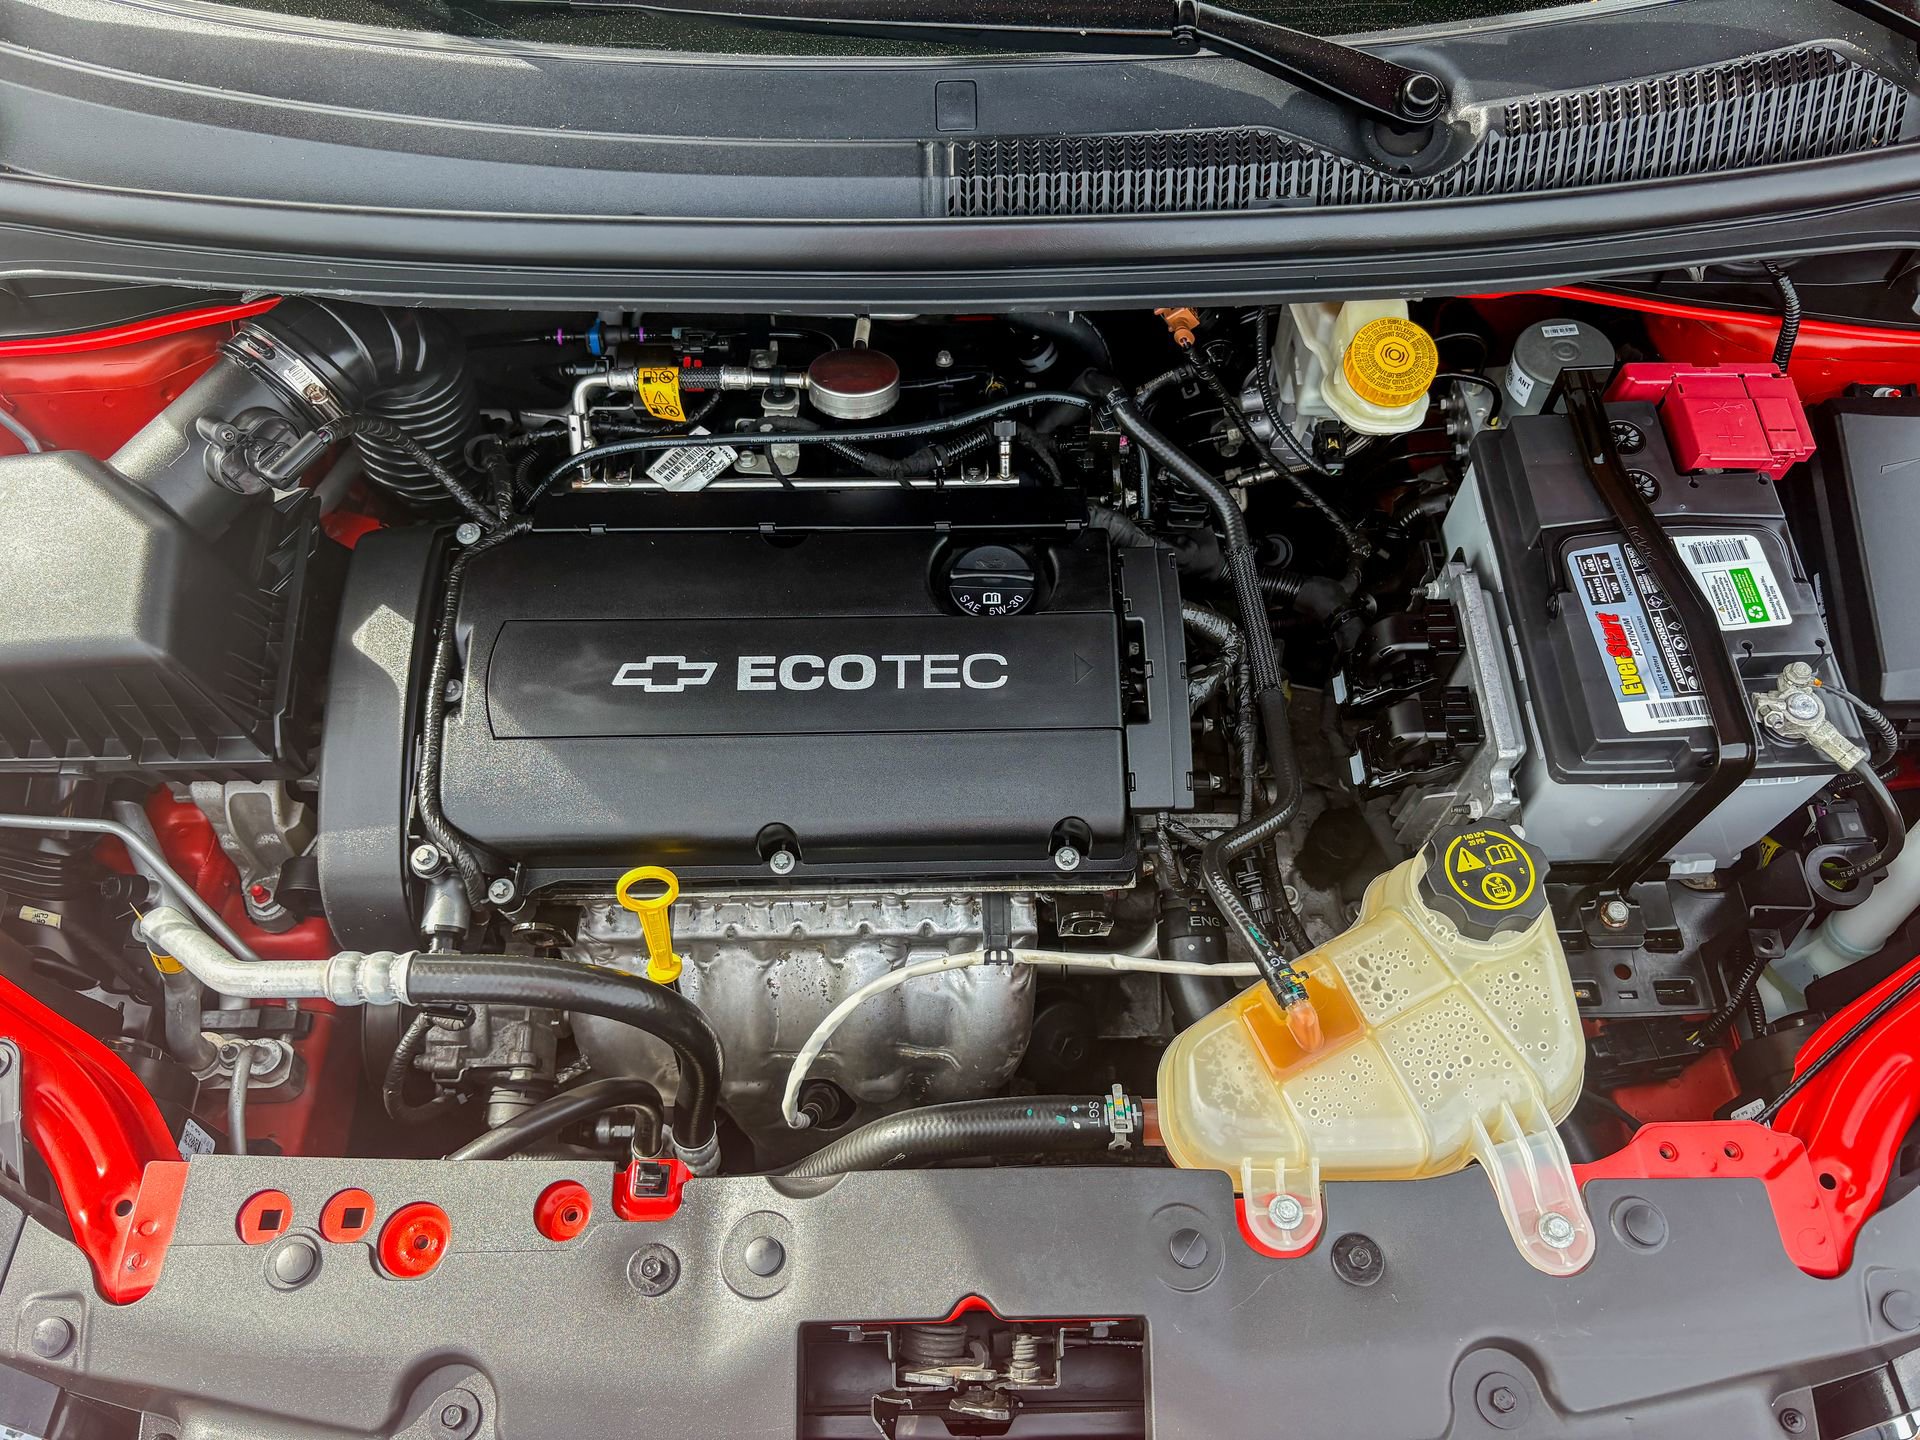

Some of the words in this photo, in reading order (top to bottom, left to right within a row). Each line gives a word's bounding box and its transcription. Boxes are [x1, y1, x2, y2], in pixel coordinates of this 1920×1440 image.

[1518, 376, 1531, 390] ANT
[1586, 558, 1596, 572] 680
[1602, 559, 1611, 568] 60
[1614, 557, 1633, 596] NONSPILLABLE
[1596, 587, 1607, 603] AGM
[1610, 582, 1621, 595] 100
[959, 594, 981, 612] SAE
[989, 595, 1024, 615] 5W-30
[1622, 617, 1643, 656] PLATINUM
[1653, 616, 1682, 678] DANGER/POISON
[1596, 612, 1646, 696] EverStart
[737, 653, 1008, 691] ECOTEC
[1189, 915, 1221, 927] ENG
[1088, 1101, 1101, 1128] SGT
